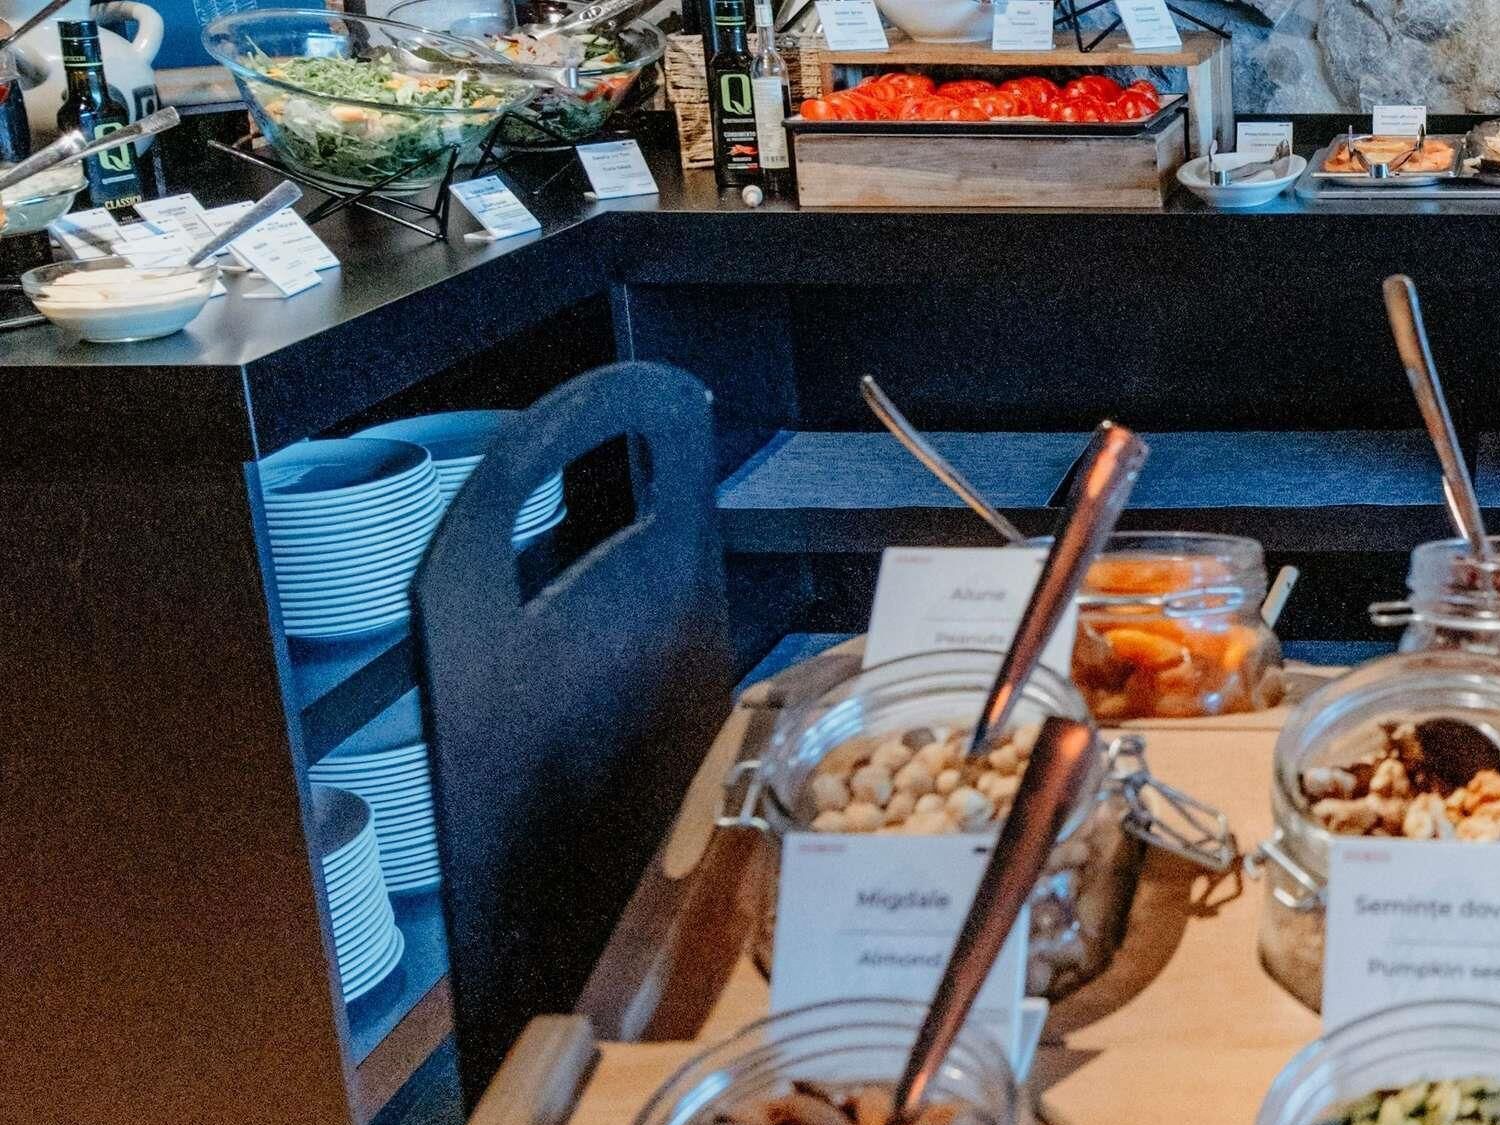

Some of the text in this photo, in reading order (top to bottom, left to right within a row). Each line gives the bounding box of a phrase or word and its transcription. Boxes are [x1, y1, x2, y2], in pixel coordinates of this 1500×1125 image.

[721, 73, 753, 115] Q
[951, 588, 1006, 602] Alune
[857, 890, 950, 912] Migdale
[1367, 958, 1463, 982] Pumpkin
